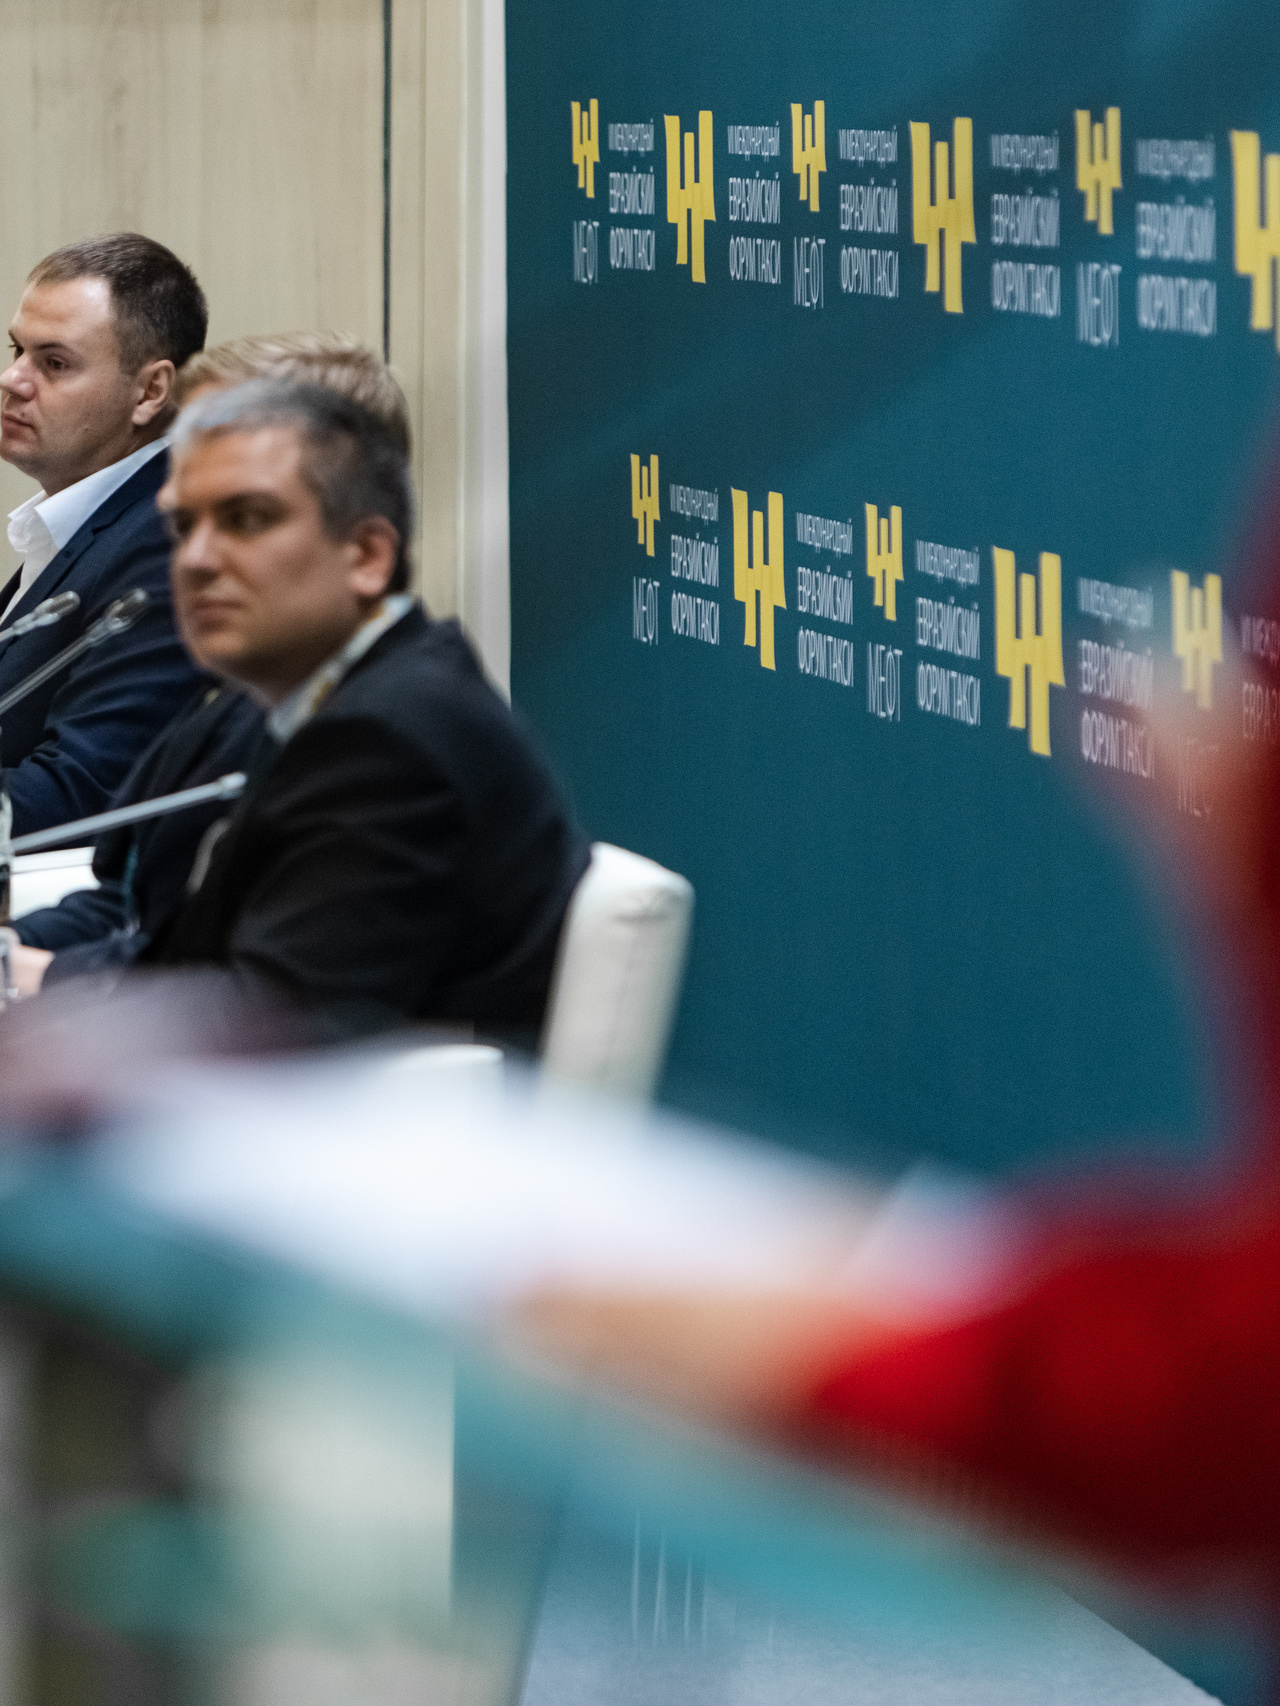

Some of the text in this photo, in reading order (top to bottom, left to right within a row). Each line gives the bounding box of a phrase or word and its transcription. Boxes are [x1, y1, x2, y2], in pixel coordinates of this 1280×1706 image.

[729, 170, 780, 224] ЕВРАЗИЙСКИЙ
[840, 178, 898, 234] ЕВРАЗИЙСКИЙ
[729, 235, 781, 284] ФОРУМ ТАКСИ
[794, 235, 826, 310] МЕФТ
[841, 246, 899, 298] ФОРУМ ТАКСИ
[671, 533, 719, 588] ЕВРАЗИЙСКИЙ
[671, 590, 720, 646] ФОРУМ ТАКСИ
[798, 565, 853, 625] ЕВРАЗИЙСКИЙ
[798, 625, 854, 688] ФОРУМ ТАКСИ
[917, 596, 980, 660] ЕВРАЗИЙСКИЙ
[869, 641, 903, 723] МЕФТ
[917, 660, 981, 727] ФОРУМ ТАКСИ
